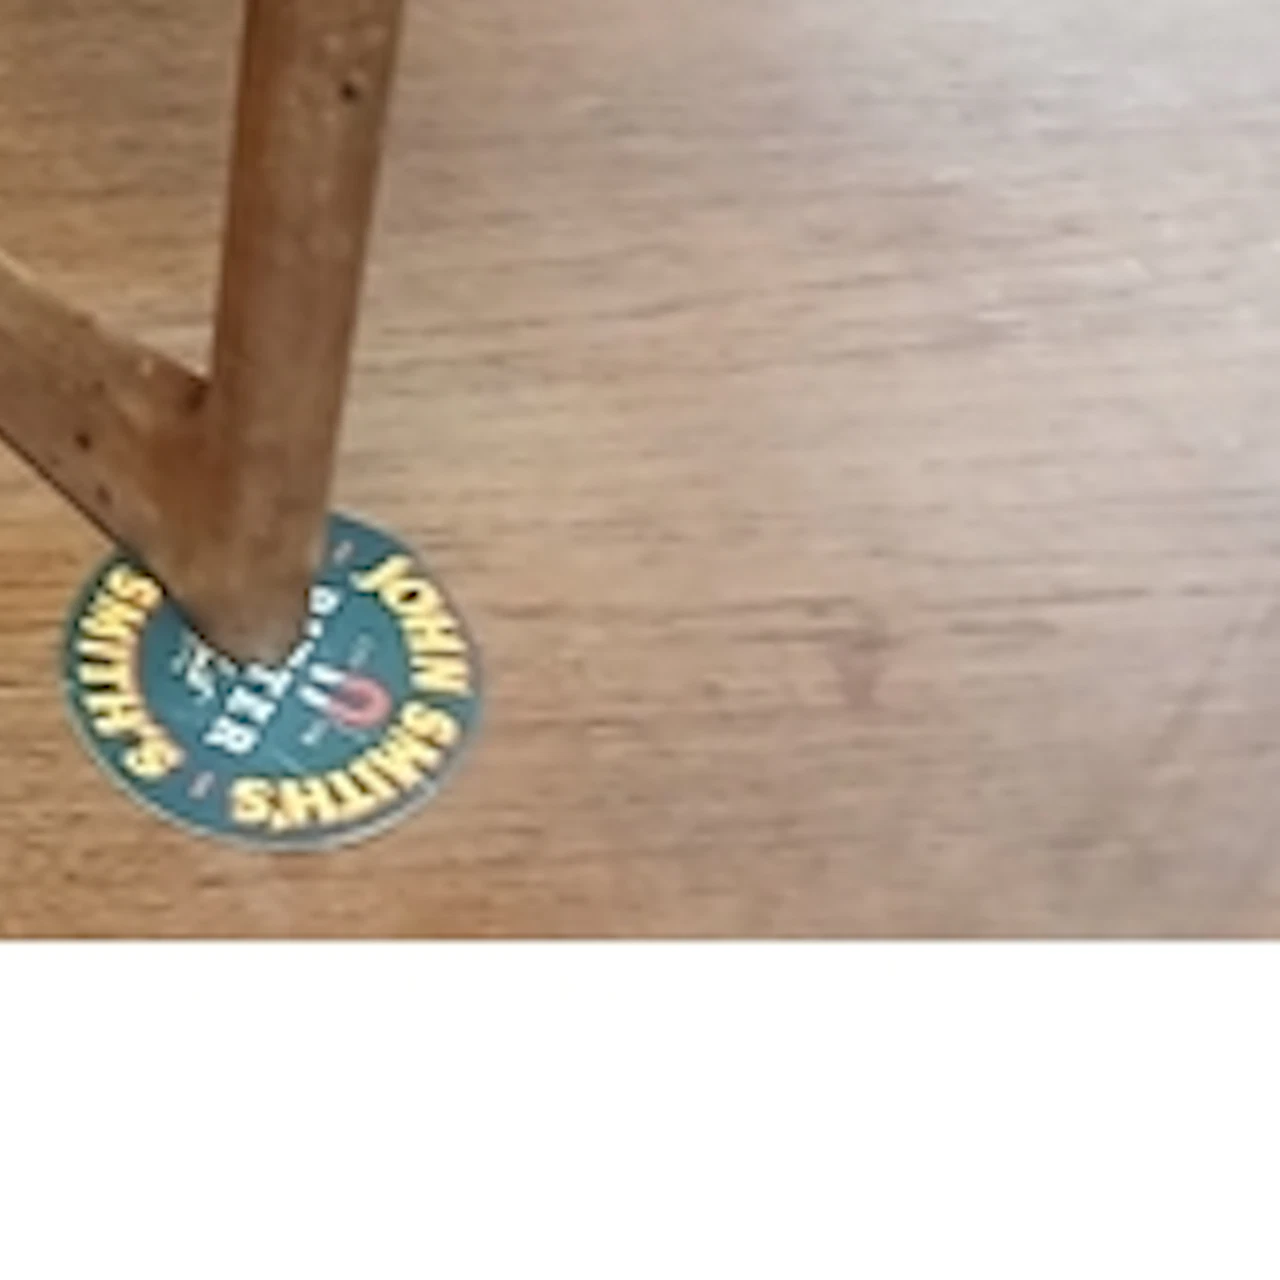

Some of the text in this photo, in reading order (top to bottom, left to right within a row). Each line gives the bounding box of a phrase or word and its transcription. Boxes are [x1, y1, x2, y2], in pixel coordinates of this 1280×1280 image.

[76, 562, 186, 781] SMITH'S
[201, 584, 339, 756] BTER
[231, 553, 471, 832] JOHN SMITH'S
